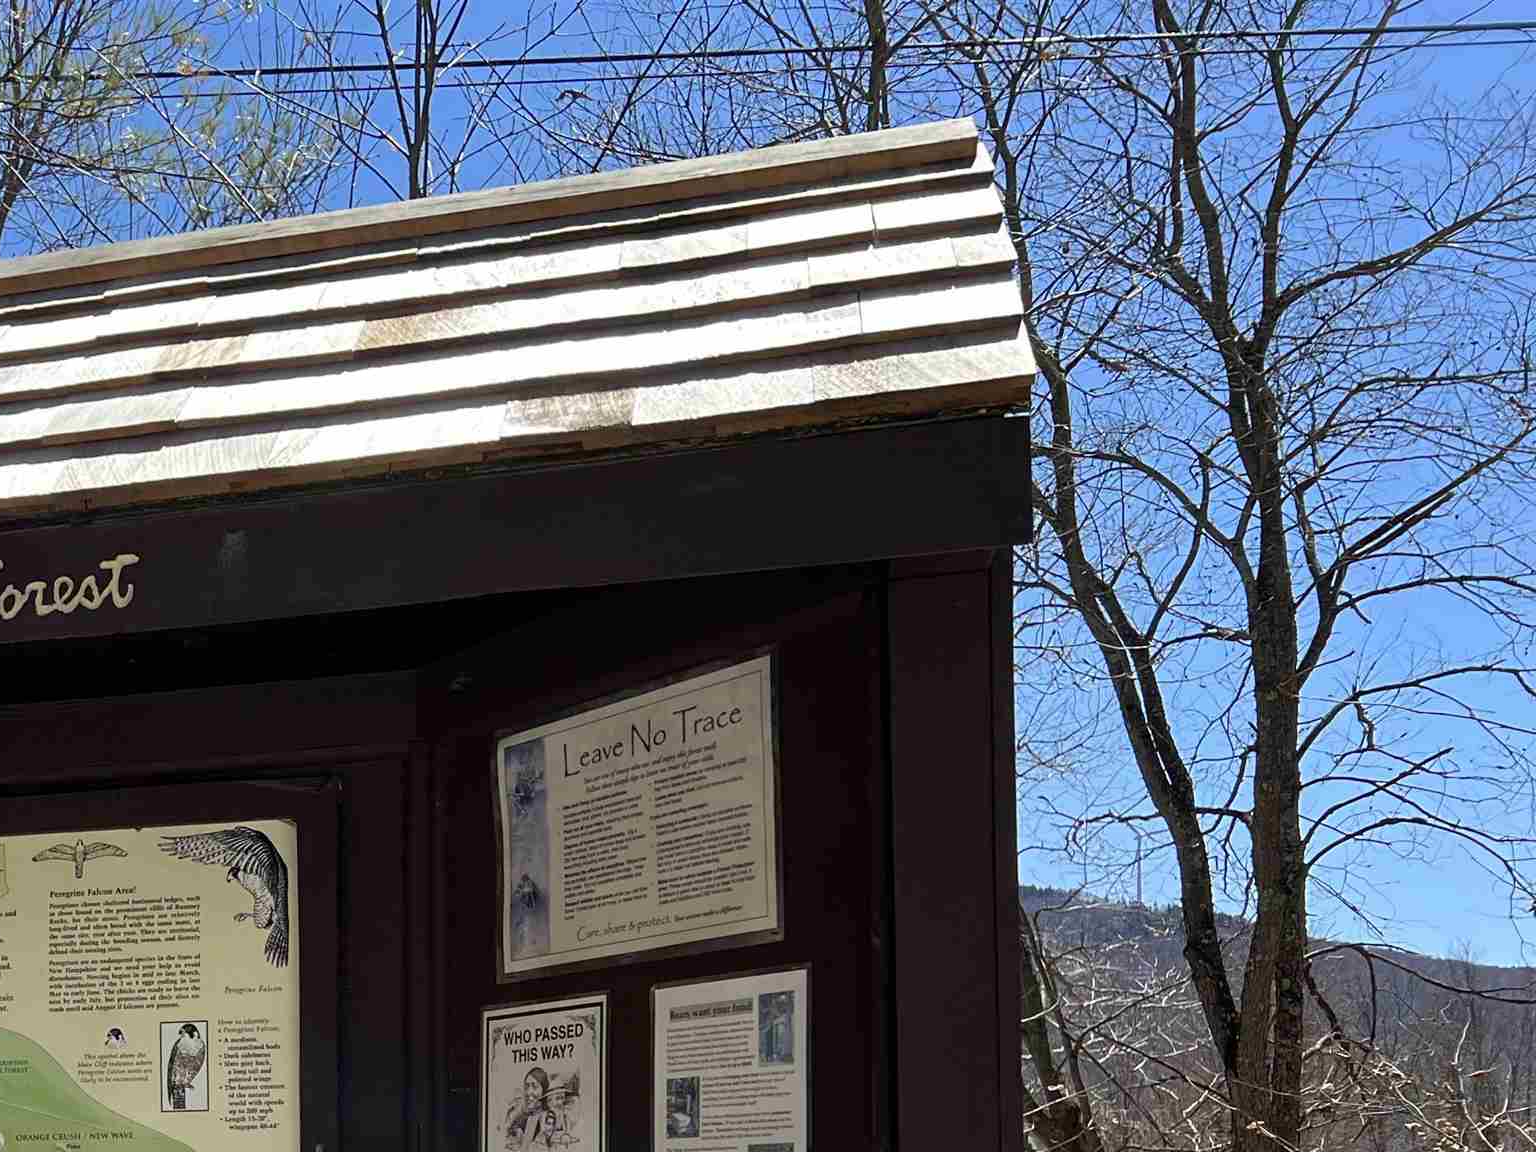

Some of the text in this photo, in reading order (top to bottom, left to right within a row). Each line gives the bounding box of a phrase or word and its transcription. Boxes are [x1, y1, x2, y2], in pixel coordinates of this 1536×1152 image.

[563, 742, 624, 779] Leave
[631, 720, 666, 757] No
[672, 705, 743, 743] Trace
[49, 885, 137, 898] Peregrine Falcon Area!
[503, 1023, 584, 1047] WHO PASSED
[511, 1043, 574, 1065] THIS WAY?
[16, 1129, 134, 1143] ORANGE CRUSH NEW WAVE
